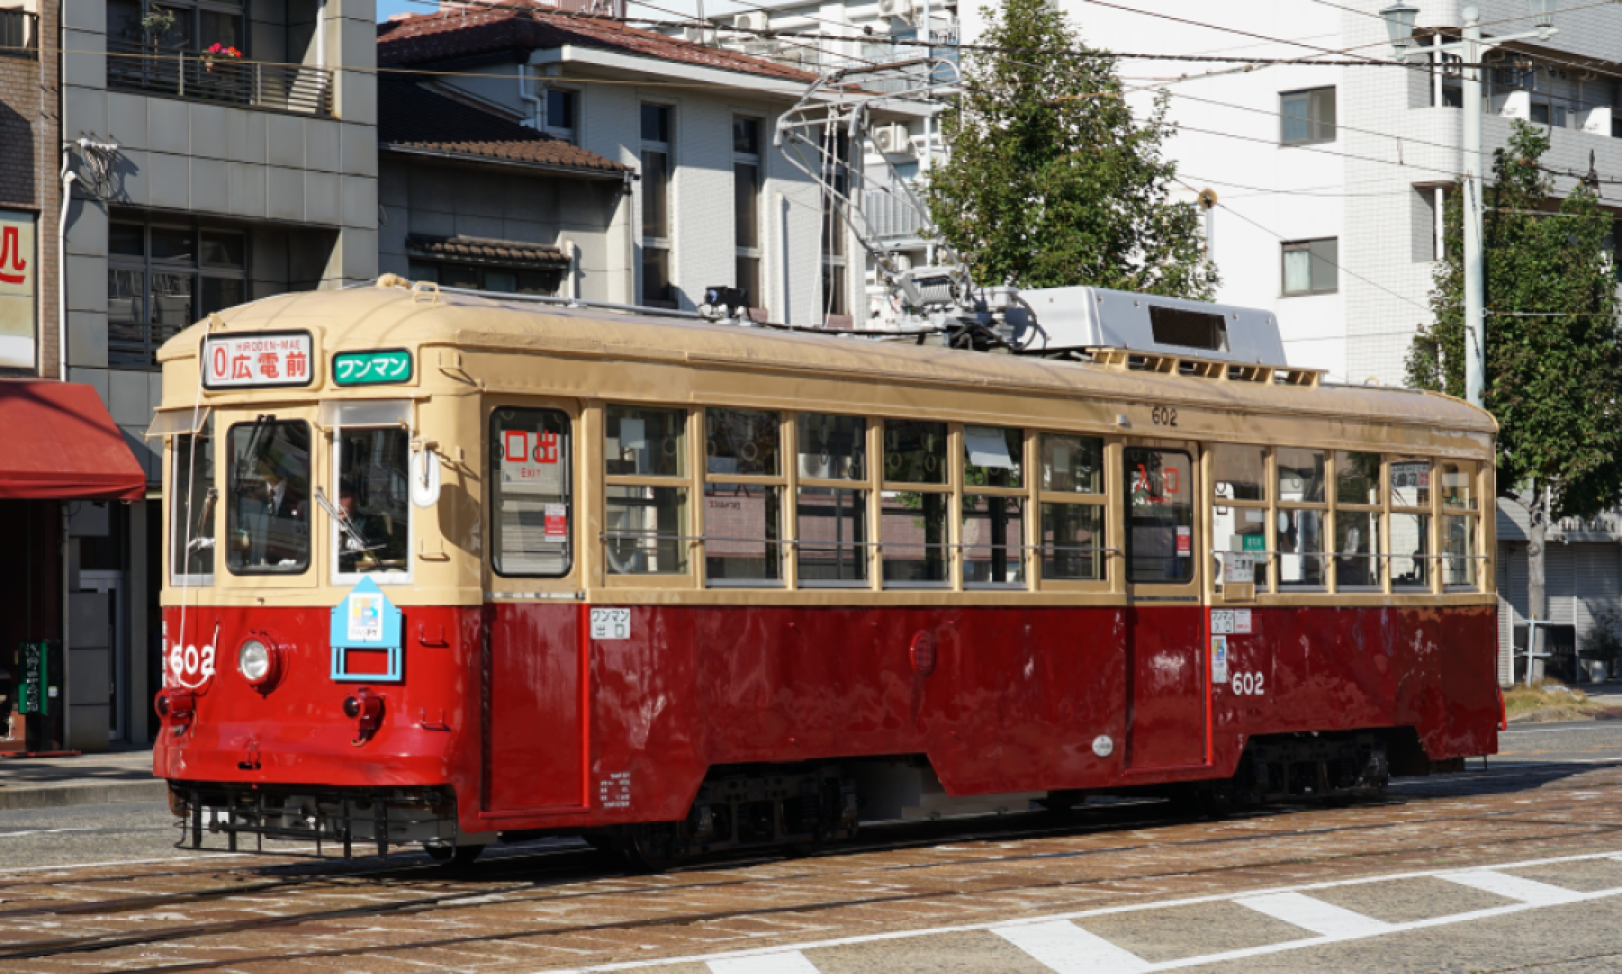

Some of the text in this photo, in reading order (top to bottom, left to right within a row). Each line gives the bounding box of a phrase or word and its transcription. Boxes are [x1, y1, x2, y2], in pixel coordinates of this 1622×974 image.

[231, 351, 307, 380] 広電前
[337, 358, 407, 379] ワンマン
[1151, 406, 1178, 427] 602
[521, 467, 542, 478] EXIT
[592, 610, 630, 622] ワンマン
[595, 623, 625, 638] 出口
[171, 644, 216, 675] 602
[1232, 672, 1264, 696] 602
